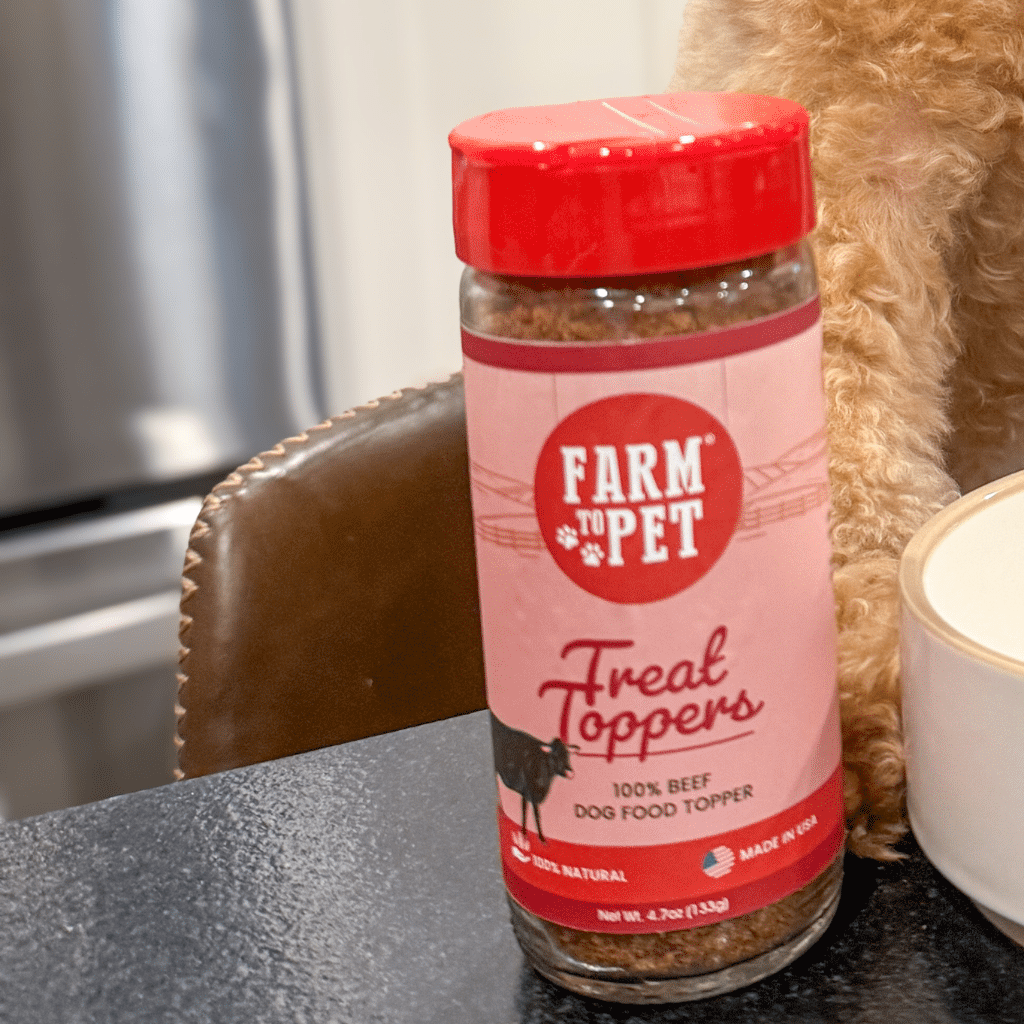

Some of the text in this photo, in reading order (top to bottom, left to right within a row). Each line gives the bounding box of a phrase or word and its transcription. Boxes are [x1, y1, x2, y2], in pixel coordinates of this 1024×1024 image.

[560, 436, 705, 504] FARM
[575, 498, 704, 567] TO PET
[560, 625, 728, 706] Treat
[538, 679, 765, 763] Toppers
[573, 783, 754, 821] DOG FOOD TOPPER
[612, 772, 712, 798] 100% BEEF
[739, 814, 819, 862] MADE IN USA
[531, 853, 628, 883] 100% NATURAL
[597, 908, 621, 923] Net
[685, 896, 730, 920] (133g)
